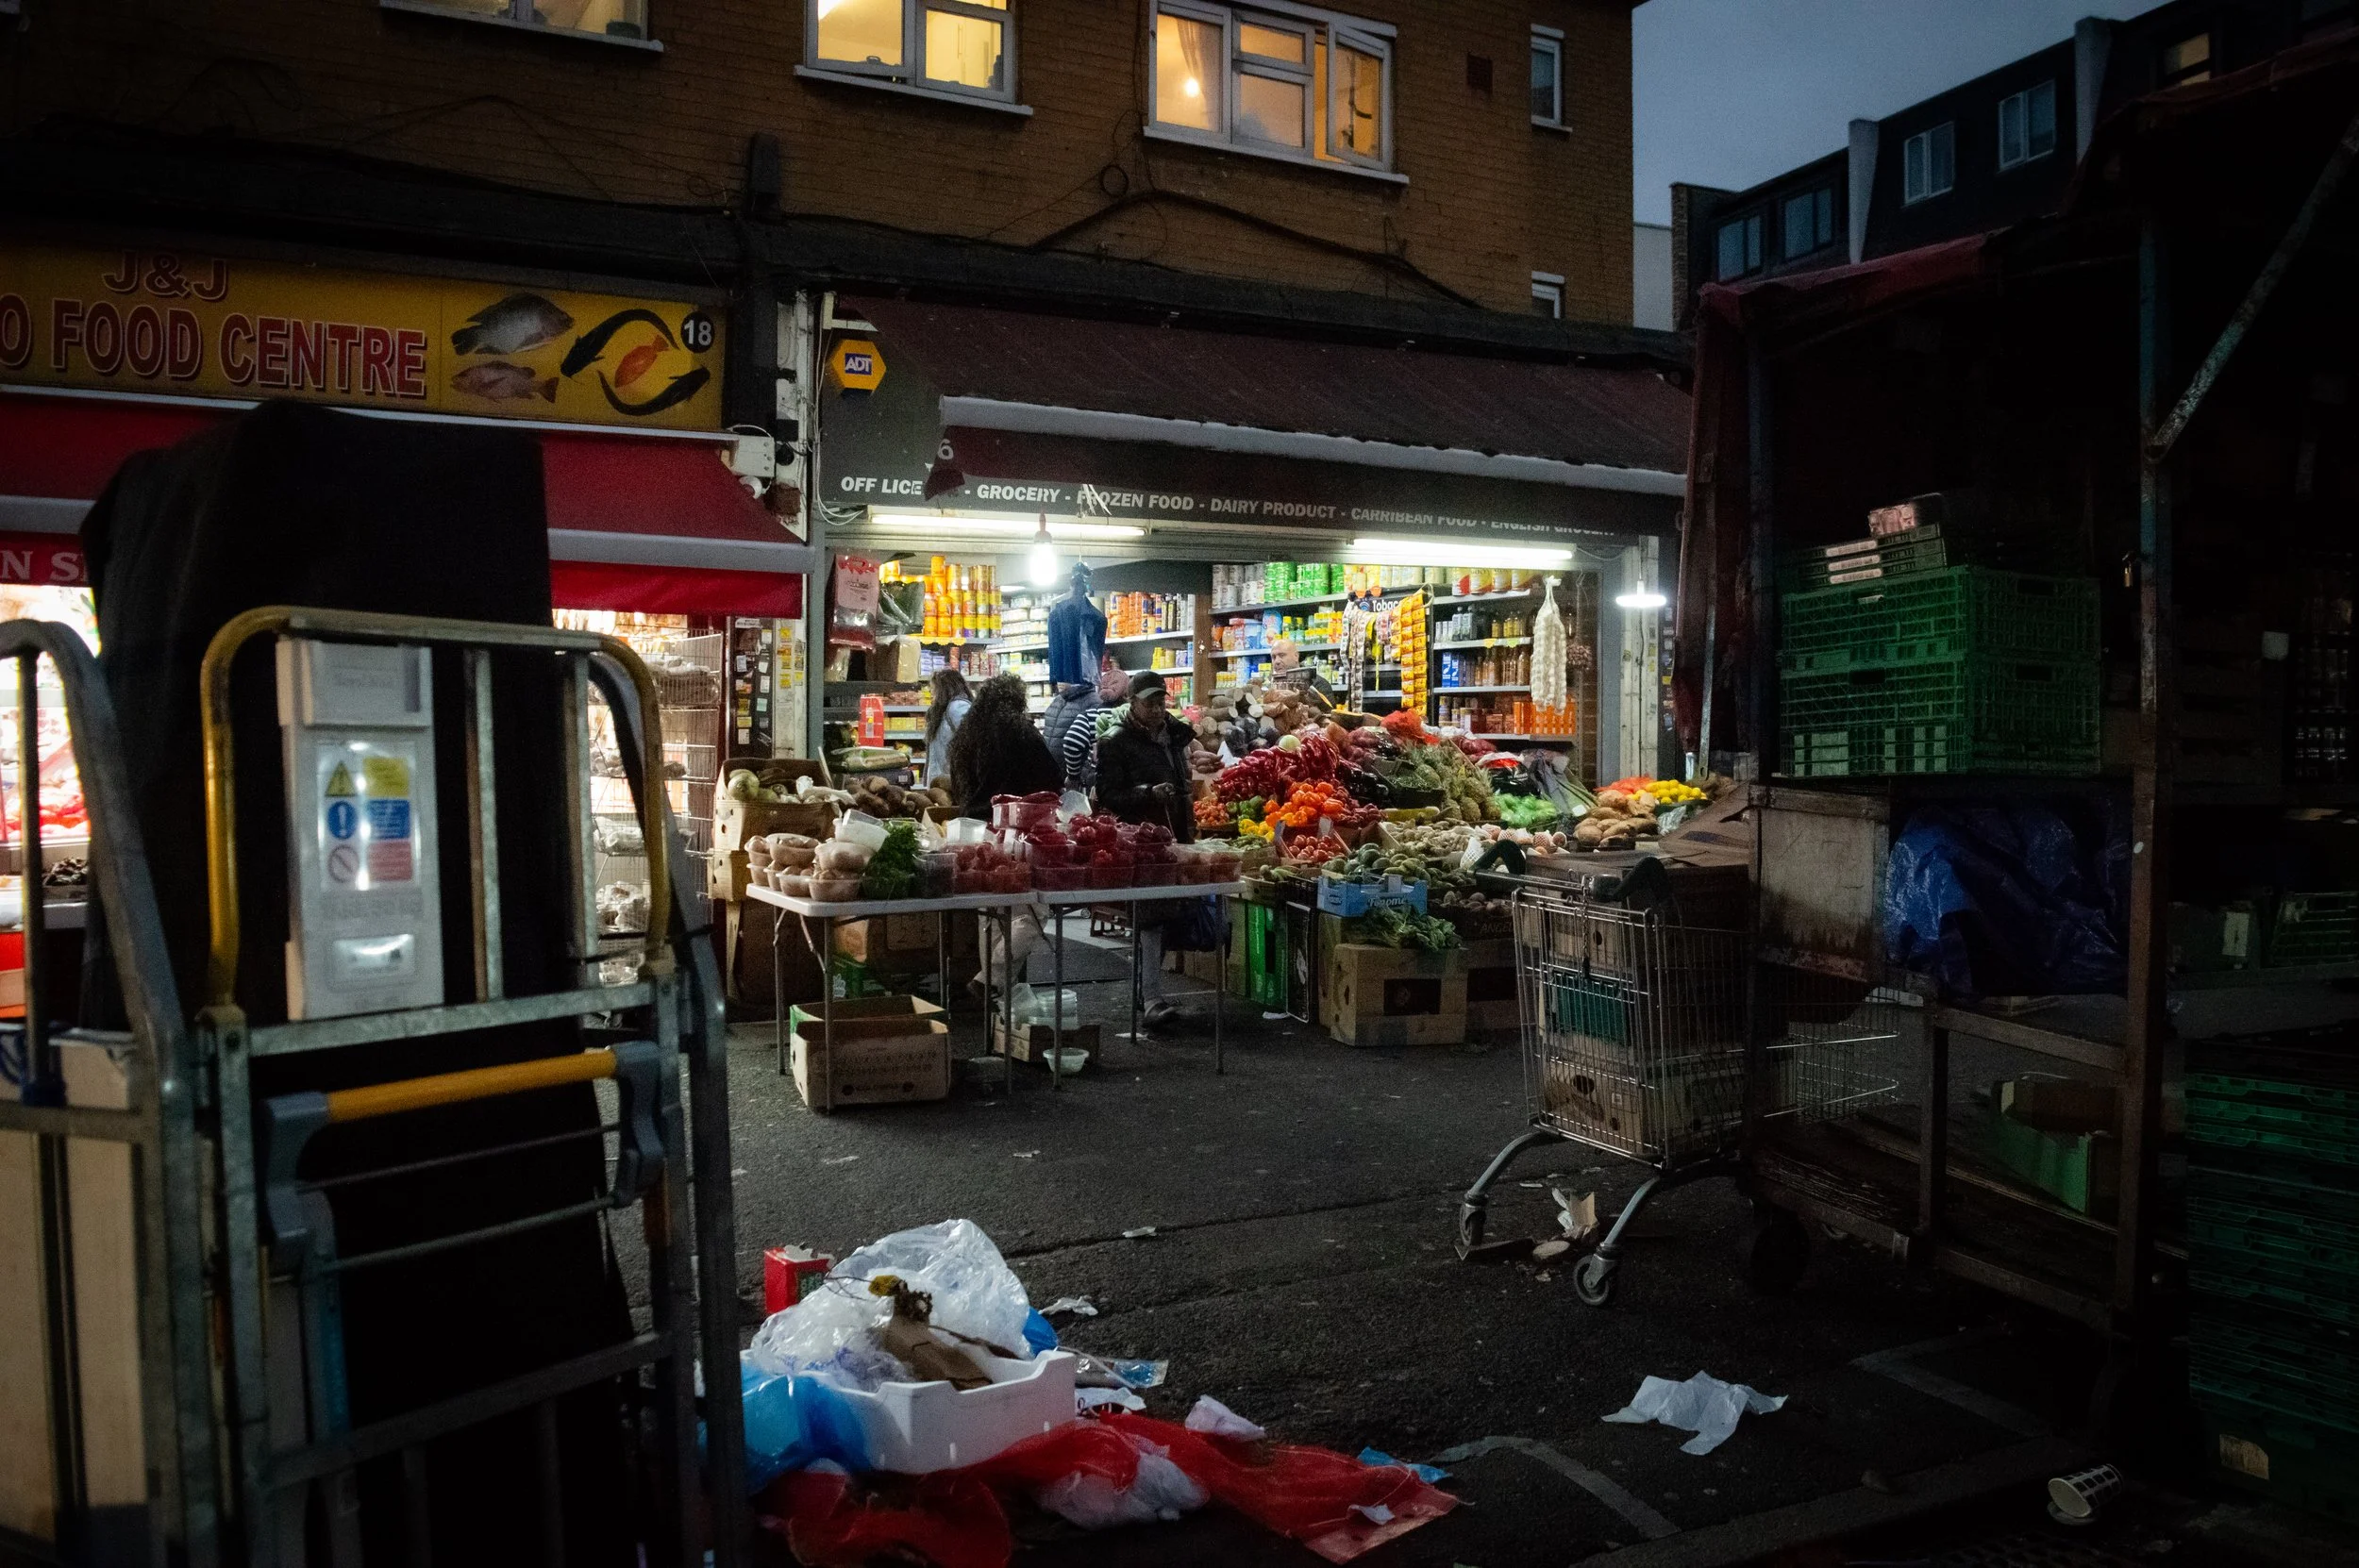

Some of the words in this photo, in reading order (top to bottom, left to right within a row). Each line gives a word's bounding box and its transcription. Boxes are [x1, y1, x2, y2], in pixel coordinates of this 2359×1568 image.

[101, 249, 228, 301] J&J
[684, 320, 712, 346] 18
[50, 297, 203, 378] FOOD
[219, 312, 427, 399] CENTRE
[845, 357, 873, 373] ADT
[937, 438, 954, 460] 6
[840, 475, 878, 492] OFF
[977, 484, 1061, 503] GROCERY
[1148, 494, 1195, 510] FOOD
[1210, 498, 1258, 515] DAIRY
[1263, 501, 1337, 519] PRODUCT
[1350, 508, 1433, 525] CARRIBEAN
[49, 551, 89, 582] S
[1372, 598, 1398, 612] Tobac
